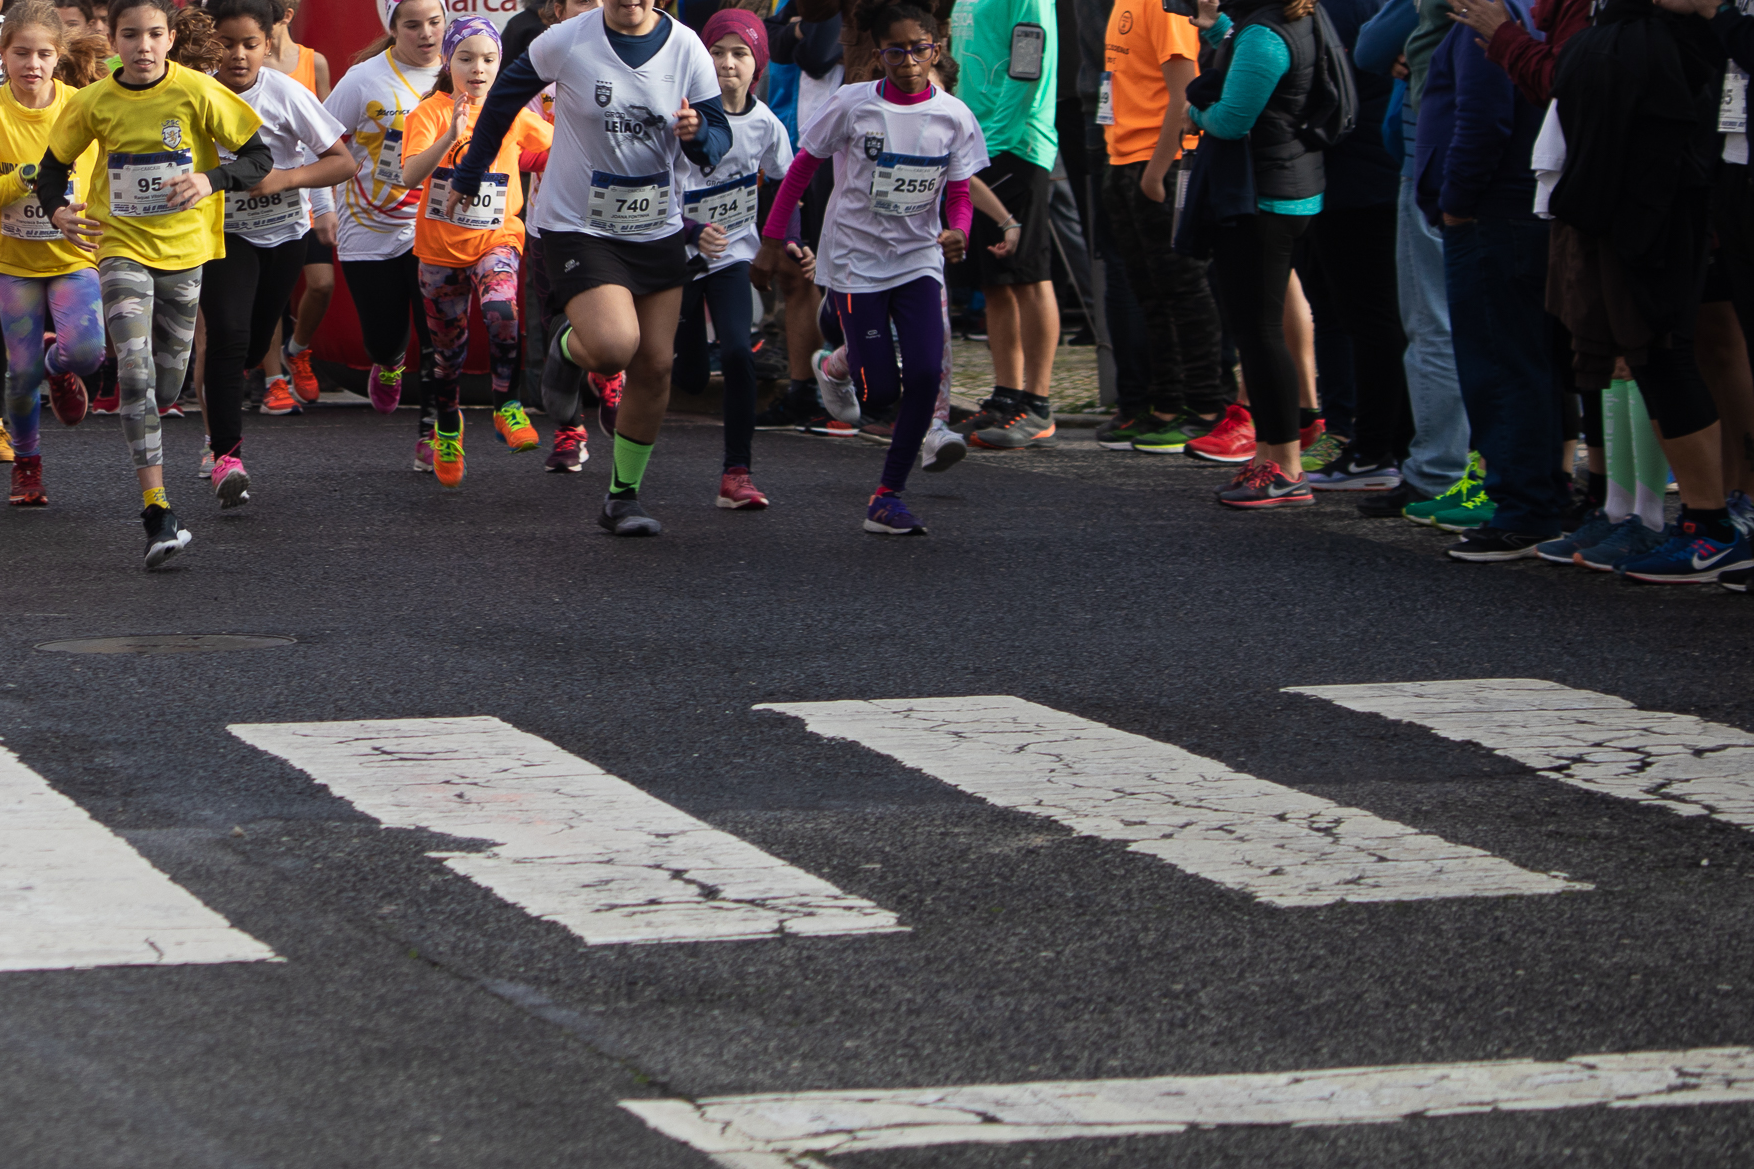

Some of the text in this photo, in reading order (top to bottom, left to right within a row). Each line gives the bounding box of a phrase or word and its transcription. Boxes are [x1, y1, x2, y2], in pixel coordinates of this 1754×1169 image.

[137, 177, 162, 193] 95
[893, 178, 936, 193] 2556
[235, 193, 282, 212] 2098
[616, 198, 649, 213] 740
[708, 199, 738, 219] 734
